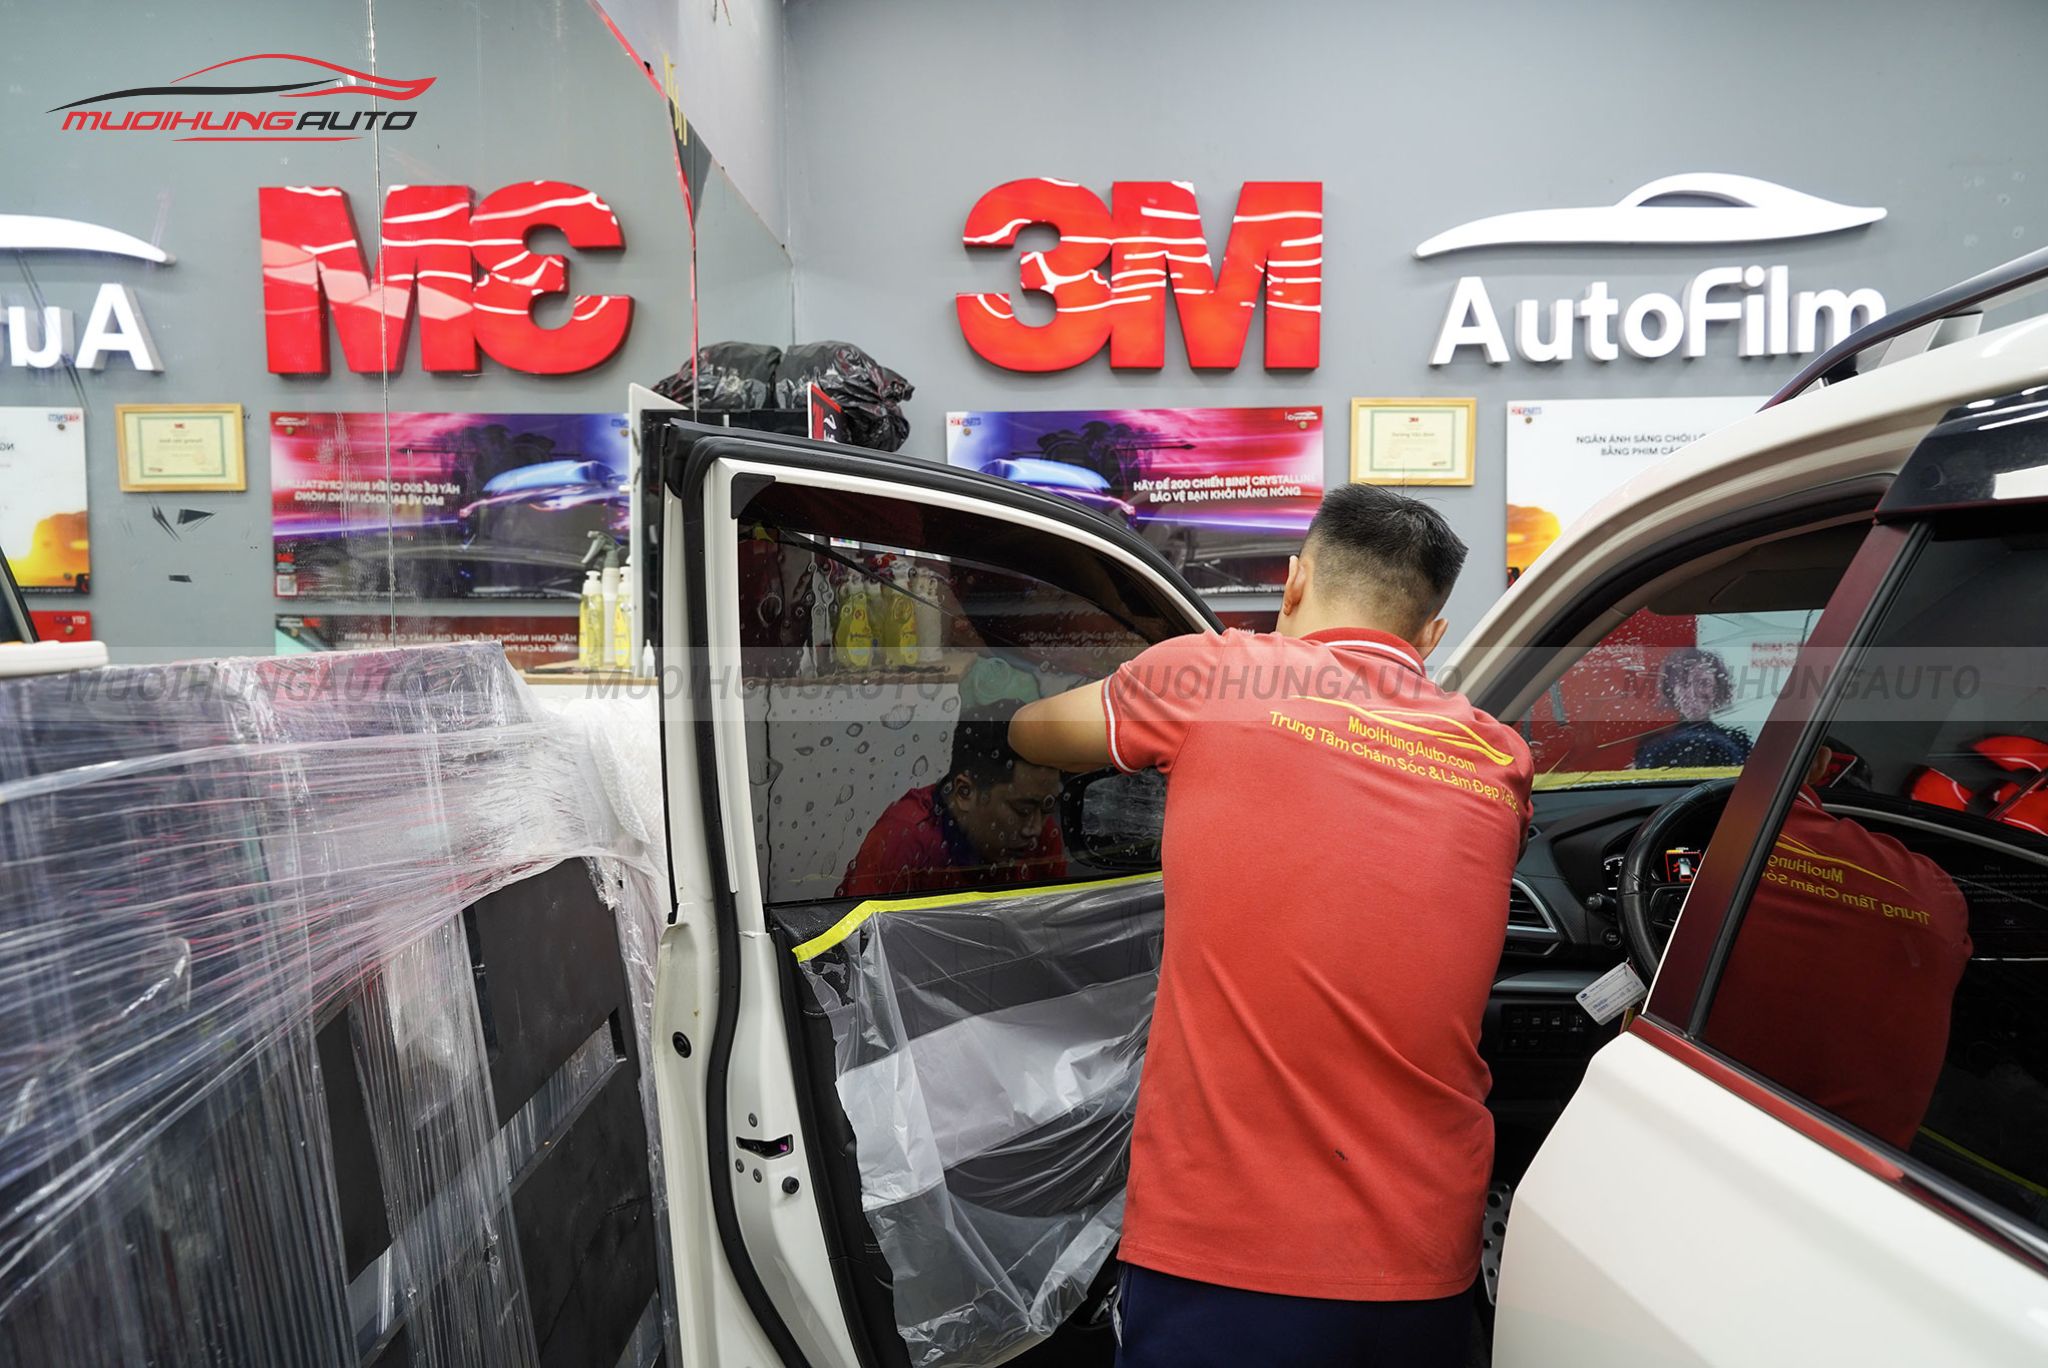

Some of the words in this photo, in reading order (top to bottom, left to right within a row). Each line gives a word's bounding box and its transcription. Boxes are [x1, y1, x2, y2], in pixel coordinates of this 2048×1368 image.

[955, 177, 1323, 373] 3M
[1133, 478, 1154, 492] HÃY
[1171, 478, 1191, 490] 200
[1192, 475, 1225, 488] CHIẾN
[1226, 476, 1250, 487] BINH
[1269, 485, 1301, 498] NÓNG
[1270, 711, 1316, 742] Trung
[1318, 727, 1350, 752] Tâm
[1351, 742, 1397, 768] Chăm
[1397, 757, 1426, 777] Sóc
[1428, 766, 1442, 781] &
[1440, 768, 1472, 792] Làm
[1472, 779, 1500, 801] Đẹp
[1347, 715, 1478, 774] MuoiHungAuto.com
